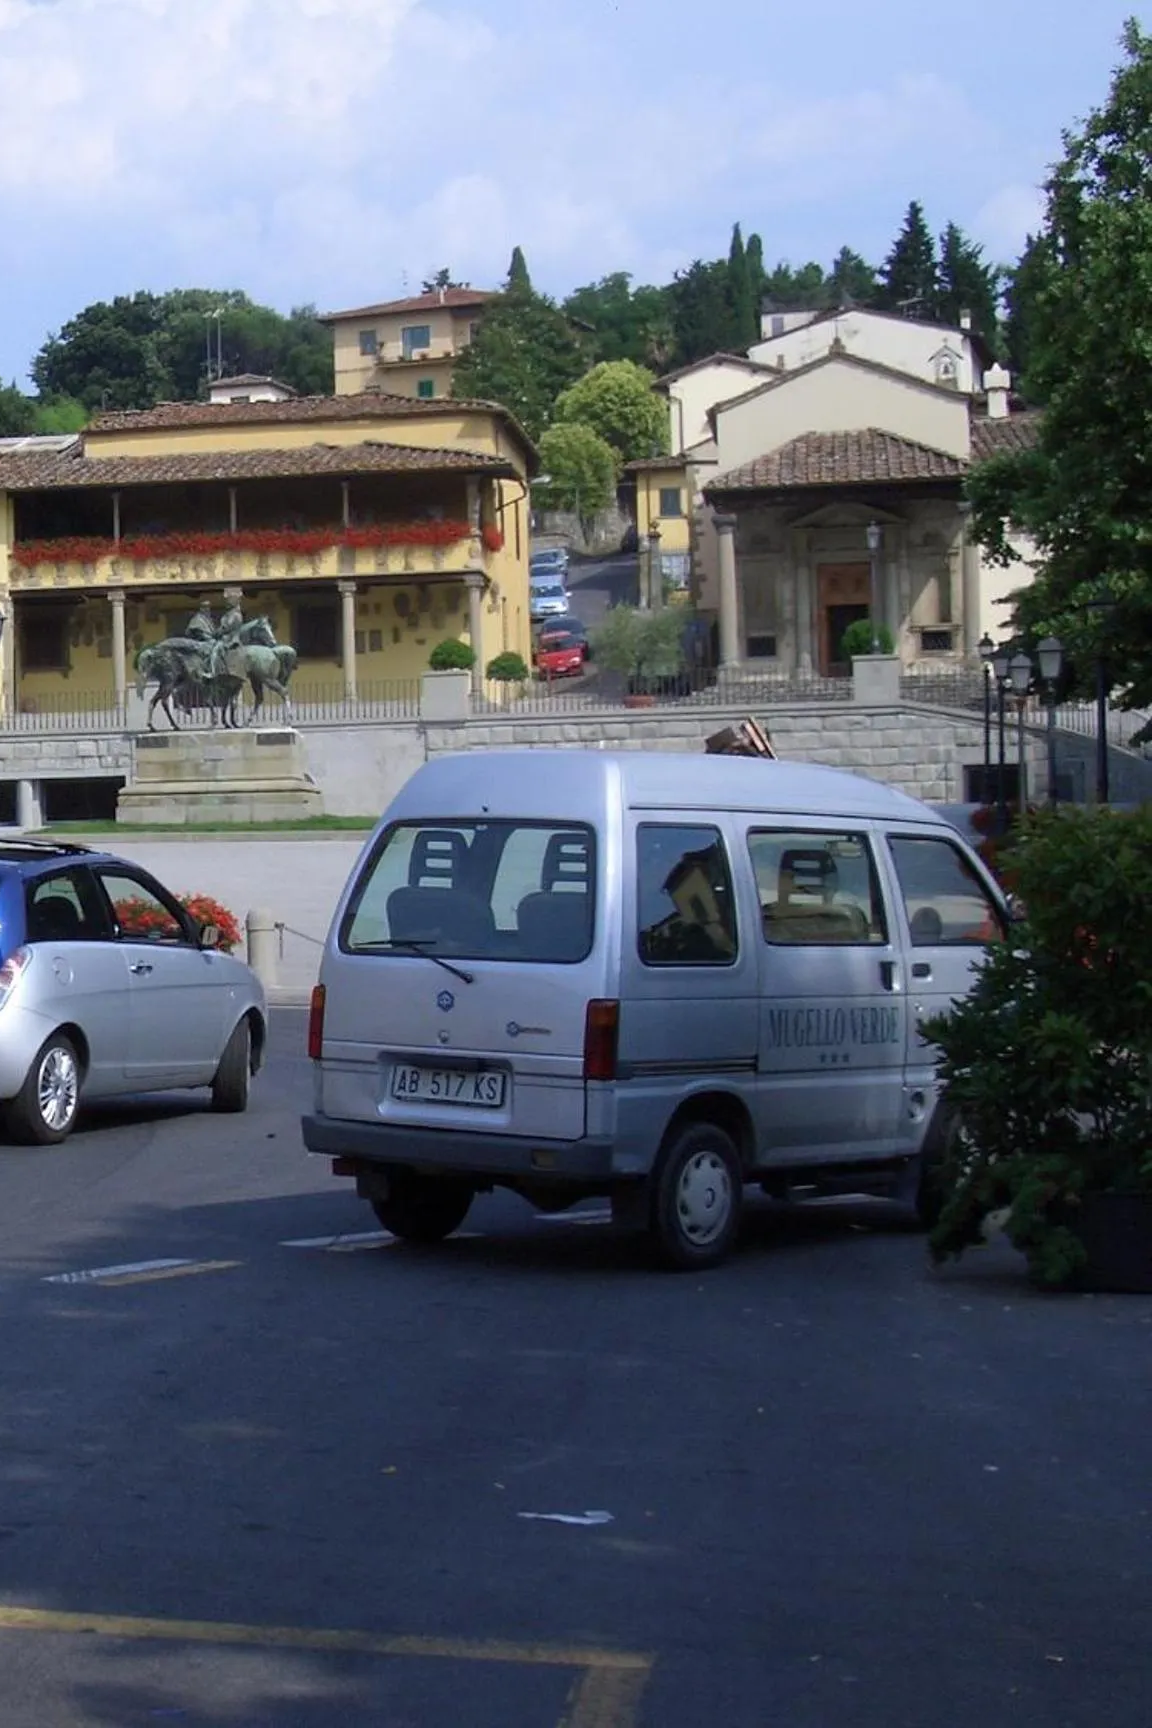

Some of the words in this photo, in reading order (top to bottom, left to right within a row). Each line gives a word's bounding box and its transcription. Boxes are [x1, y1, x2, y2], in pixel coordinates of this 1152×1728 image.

[767, 1008, 846, 1049] MUGELLO
[850, 1006, 900, 1045] VERDE
[397, 1069, 421, 1094] AB
[430, 1071, 467, 1097] 517
[473, 1075, 498, 1101] KS
